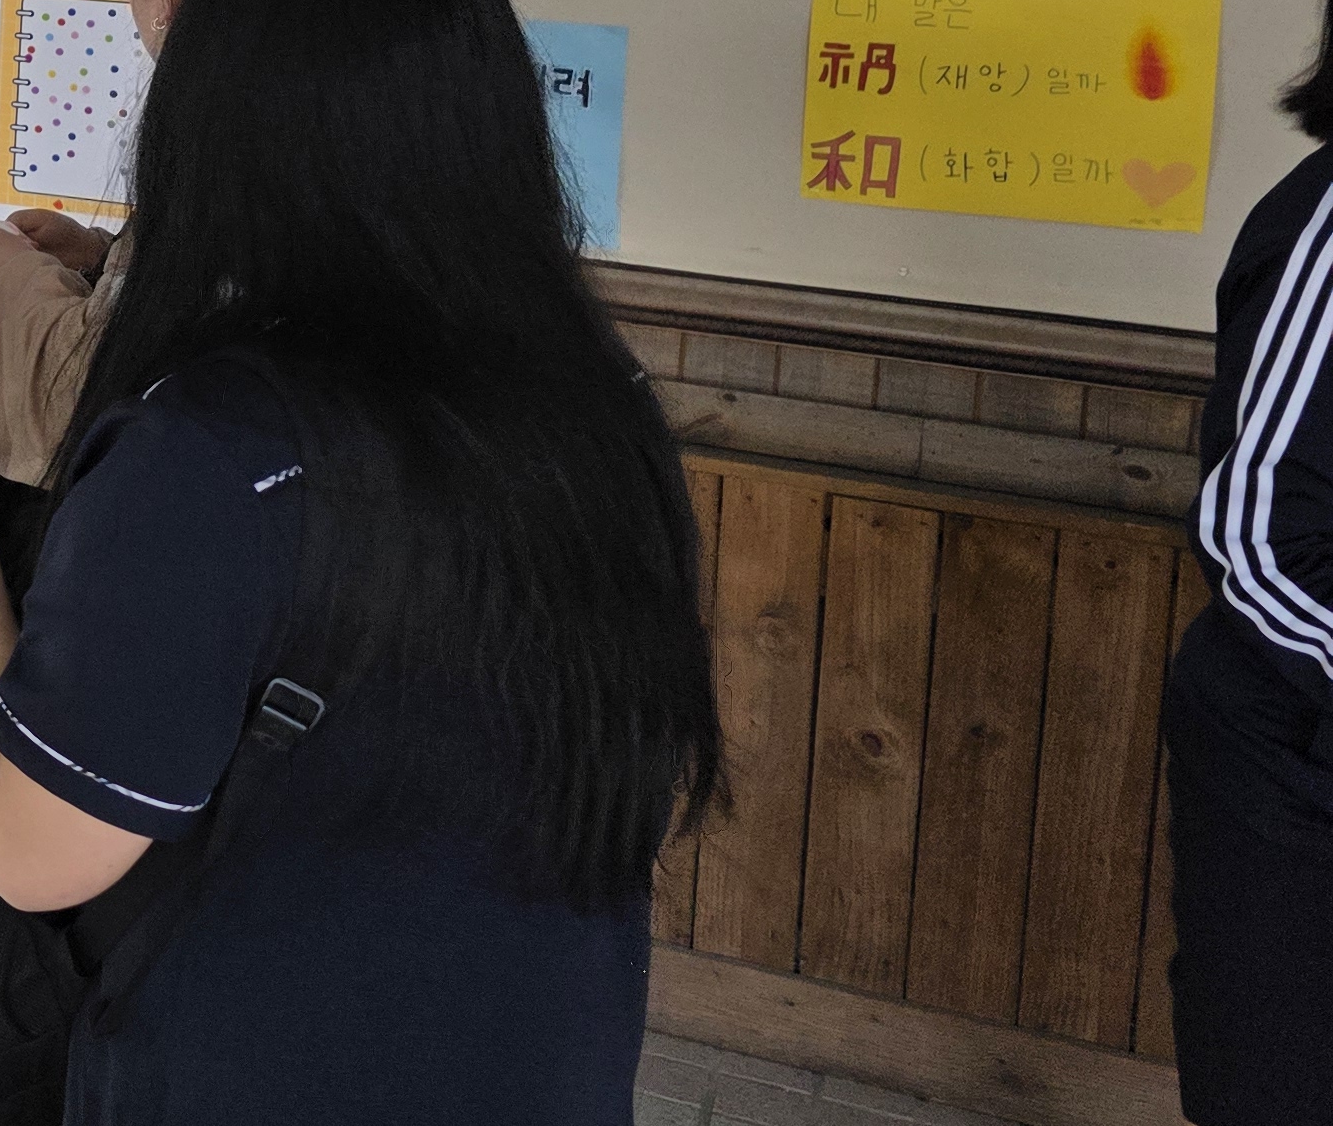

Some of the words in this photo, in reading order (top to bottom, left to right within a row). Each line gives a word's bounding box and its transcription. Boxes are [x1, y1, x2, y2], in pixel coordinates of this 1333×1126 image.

[540, 64, 591, 108] 려
[1047, 68, 1107, 95] 일까
[807, 130, 902, 198] 和
[1052, 153, 1114, 185] 일까
